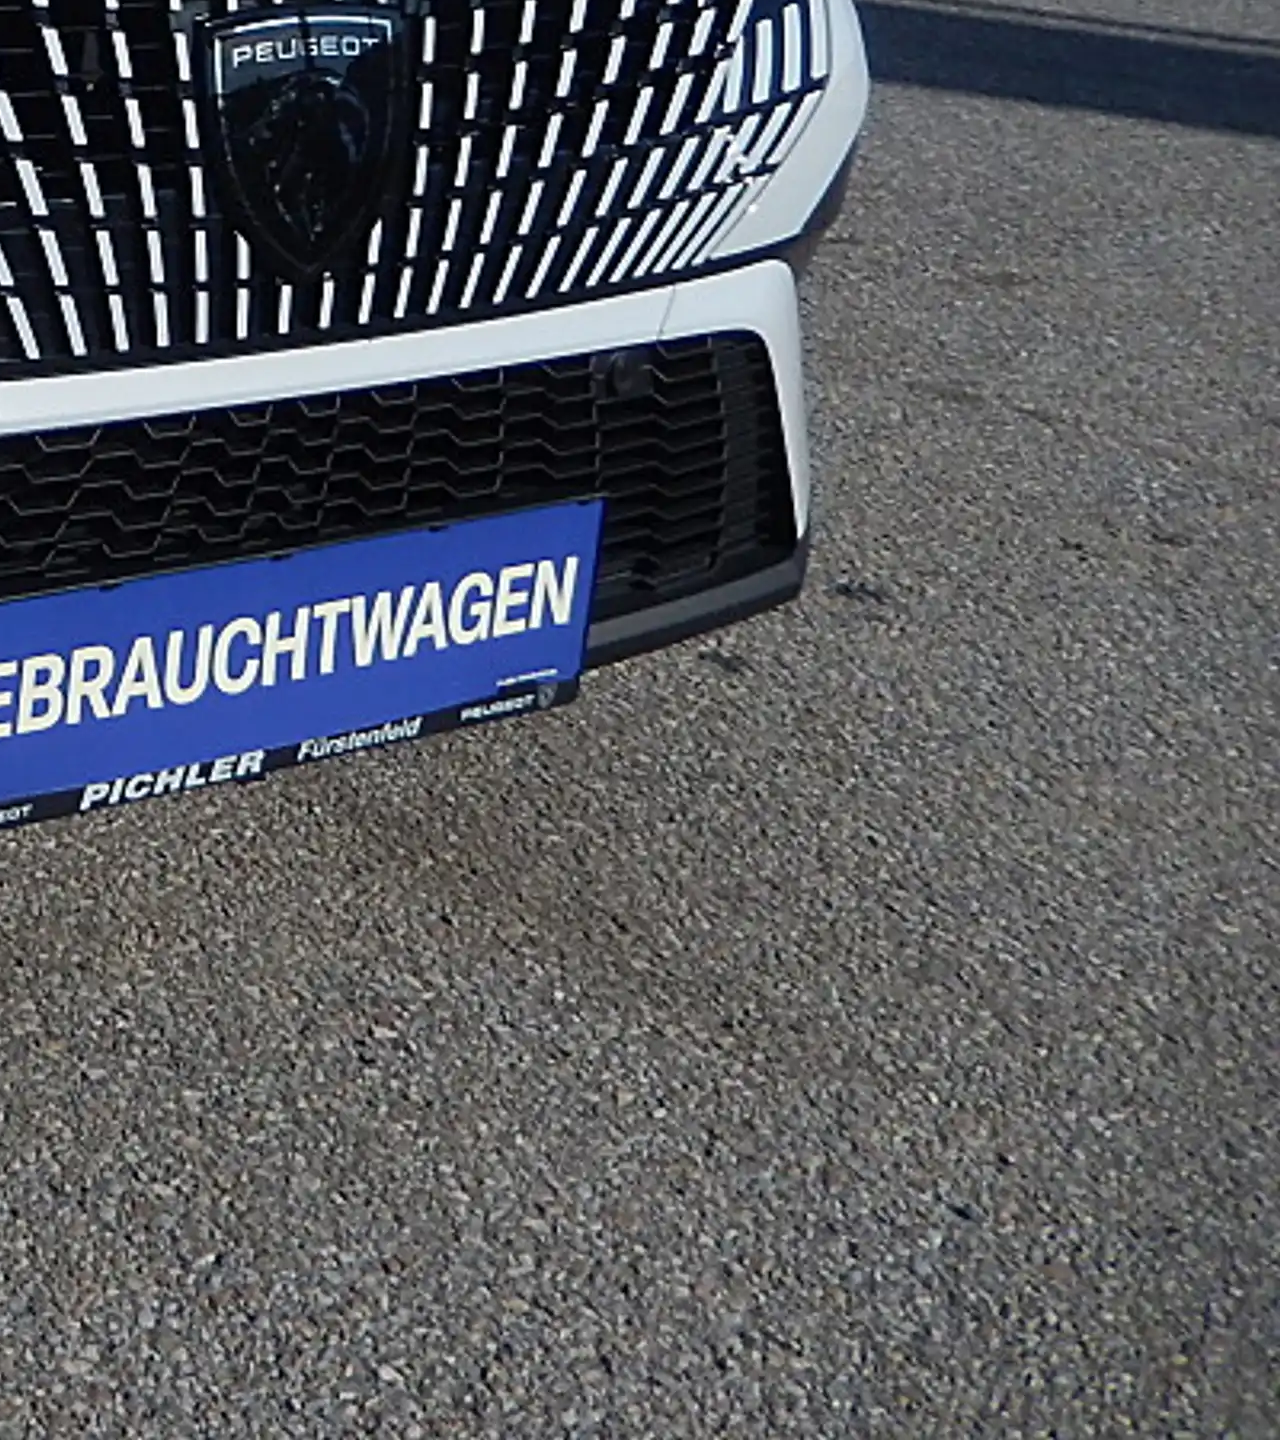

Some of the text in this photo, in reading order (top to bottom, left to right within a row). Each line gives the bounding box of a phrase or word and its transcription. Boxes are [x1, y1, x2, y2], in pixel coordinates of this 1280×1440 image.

[231, 34, 380, 70] PEUGEOT
[78, 748, 266, 812] PICHLER
[296, 715, 424, 763] Fürstenfeld
[459, 692, 537, 722] PEUGEOT
